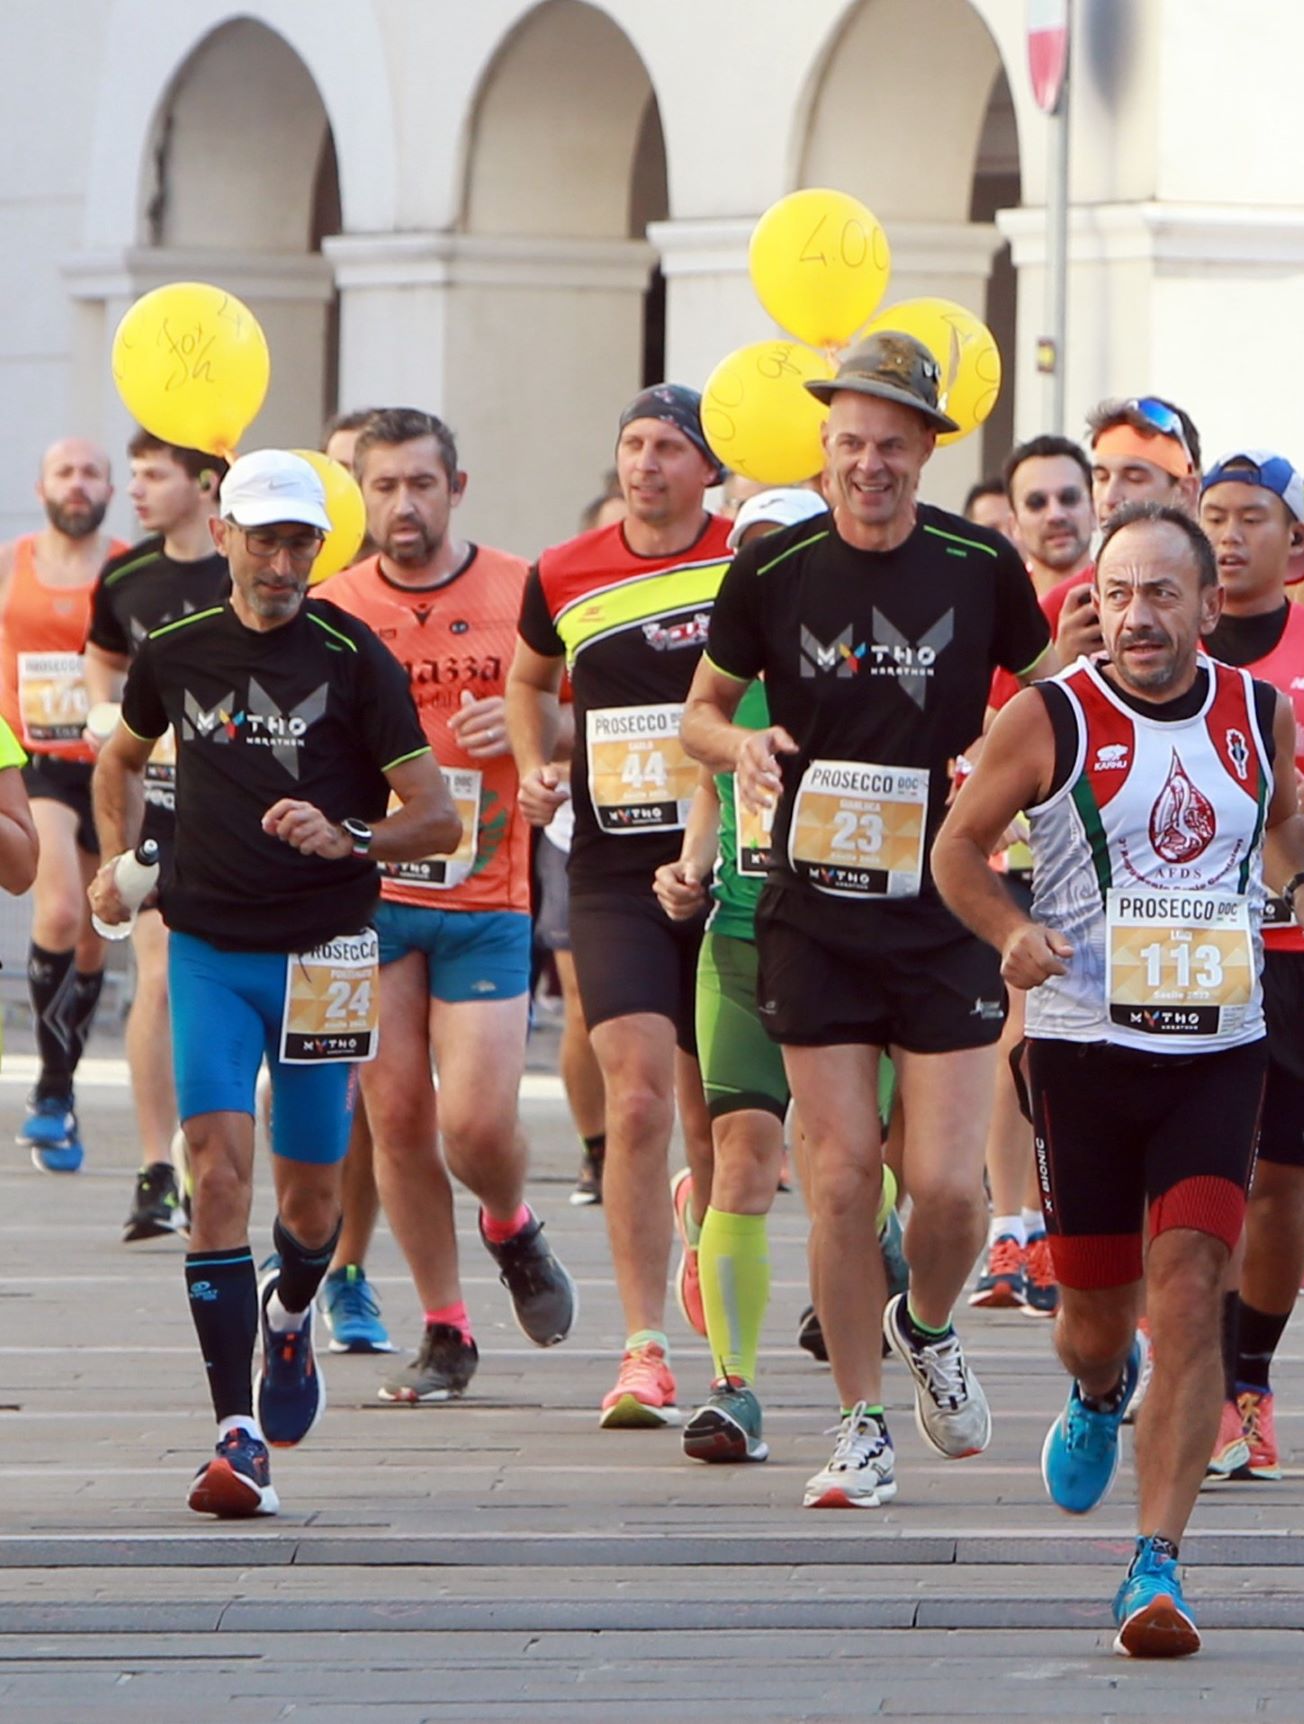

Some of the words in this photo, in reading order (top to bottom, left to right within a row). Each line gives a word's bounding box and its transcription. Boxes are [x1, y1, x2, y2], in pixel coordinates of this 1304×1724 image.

[817, 642, 936, 674] MYTHO
[197, 708, 307, 740] MYTHO
[593, 713, 667, 736] PROSECCO
[621, 751, 667, 788] 44
[1094, 759, 1127, 771] KARHU
[810, 768, 893, 794] PROSECCO
[897, 777, 919, 790] DOC
[831, 811, 884, 853] 23
[809, 867, 871, 883] MYTHO
[1155, 867, 1202, 879] AFDS
[1119, 897, 1214, 920] PROSECCO
[1217, 901, 1238, 916] DOC
[1140, 943, 1223, 988] 113
[325, 980, 371, 1018] 24
[1130, 1010, 1200, 1027] MYTHO
[1035, 1137, 1052, 1193] BIONIC
